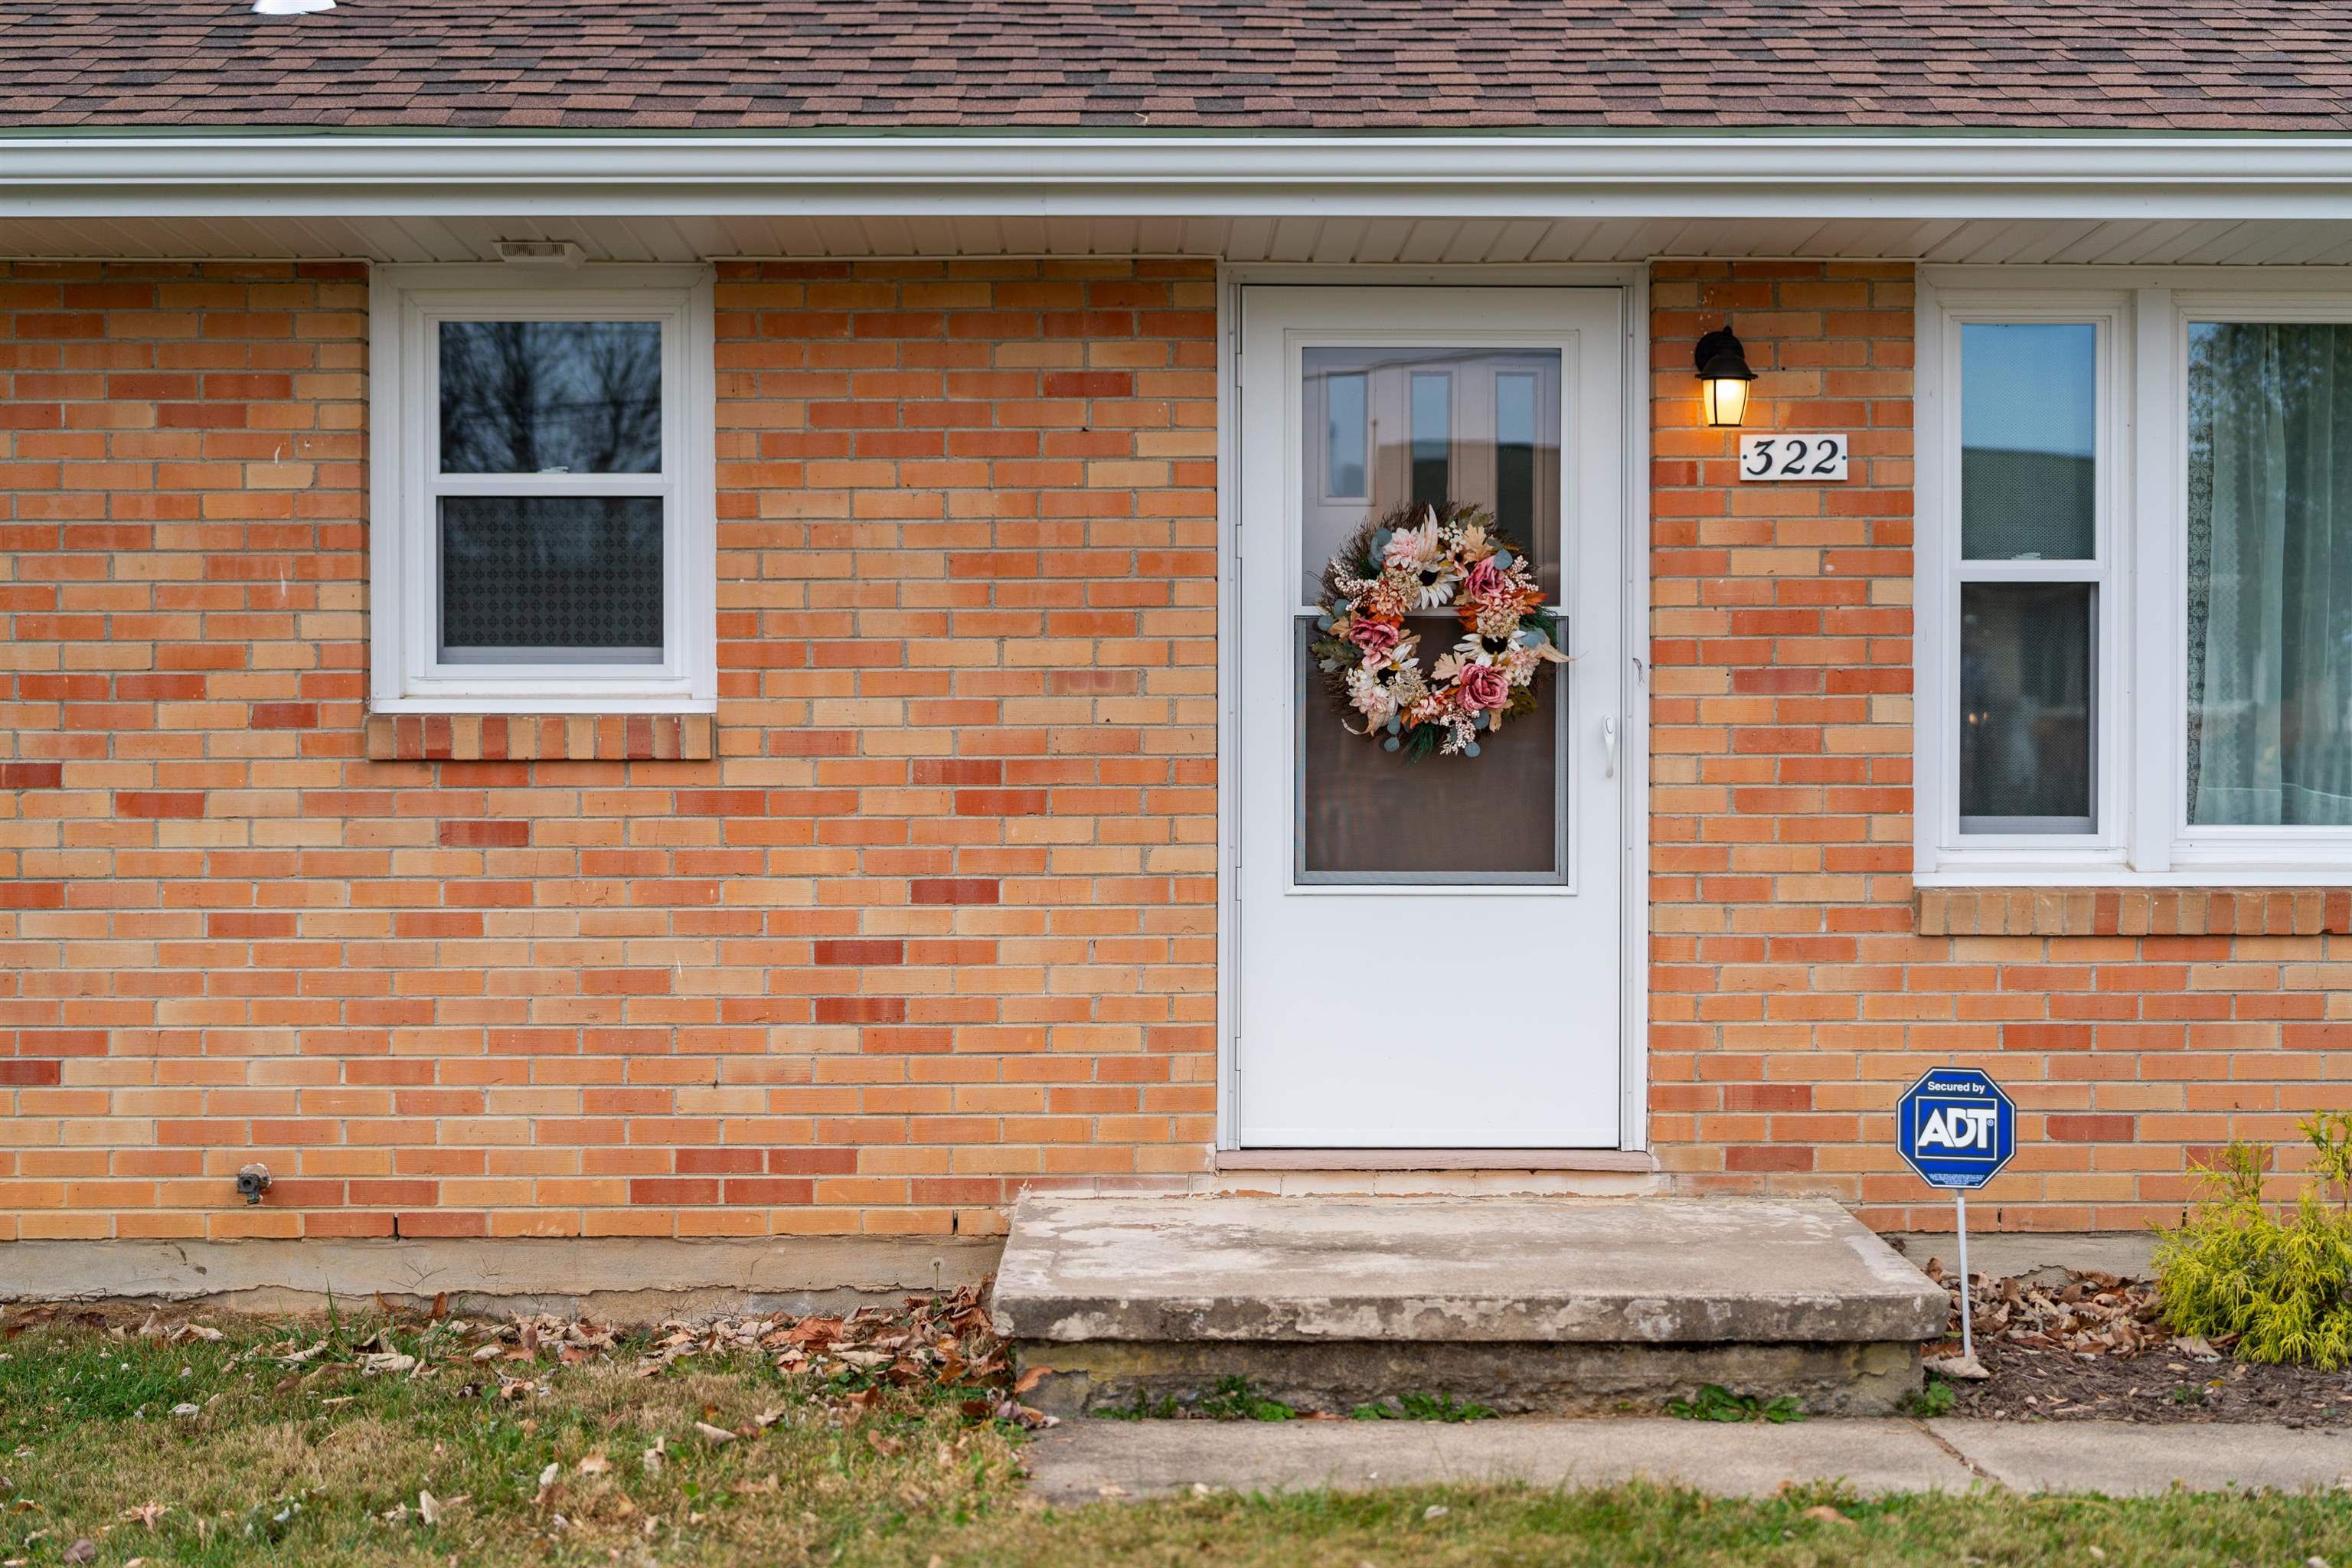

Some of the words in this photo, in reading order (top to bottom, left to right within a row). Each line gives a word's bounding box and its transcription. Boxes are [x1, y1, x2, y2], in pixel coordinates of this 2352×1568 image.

[1746, 439, 1839, 475] 322
[1927, 1081, 1970, 1092] Secured
[1972, 1083, 1985, 1094] by
[1917, 1107, 1996, 1148] ADT
